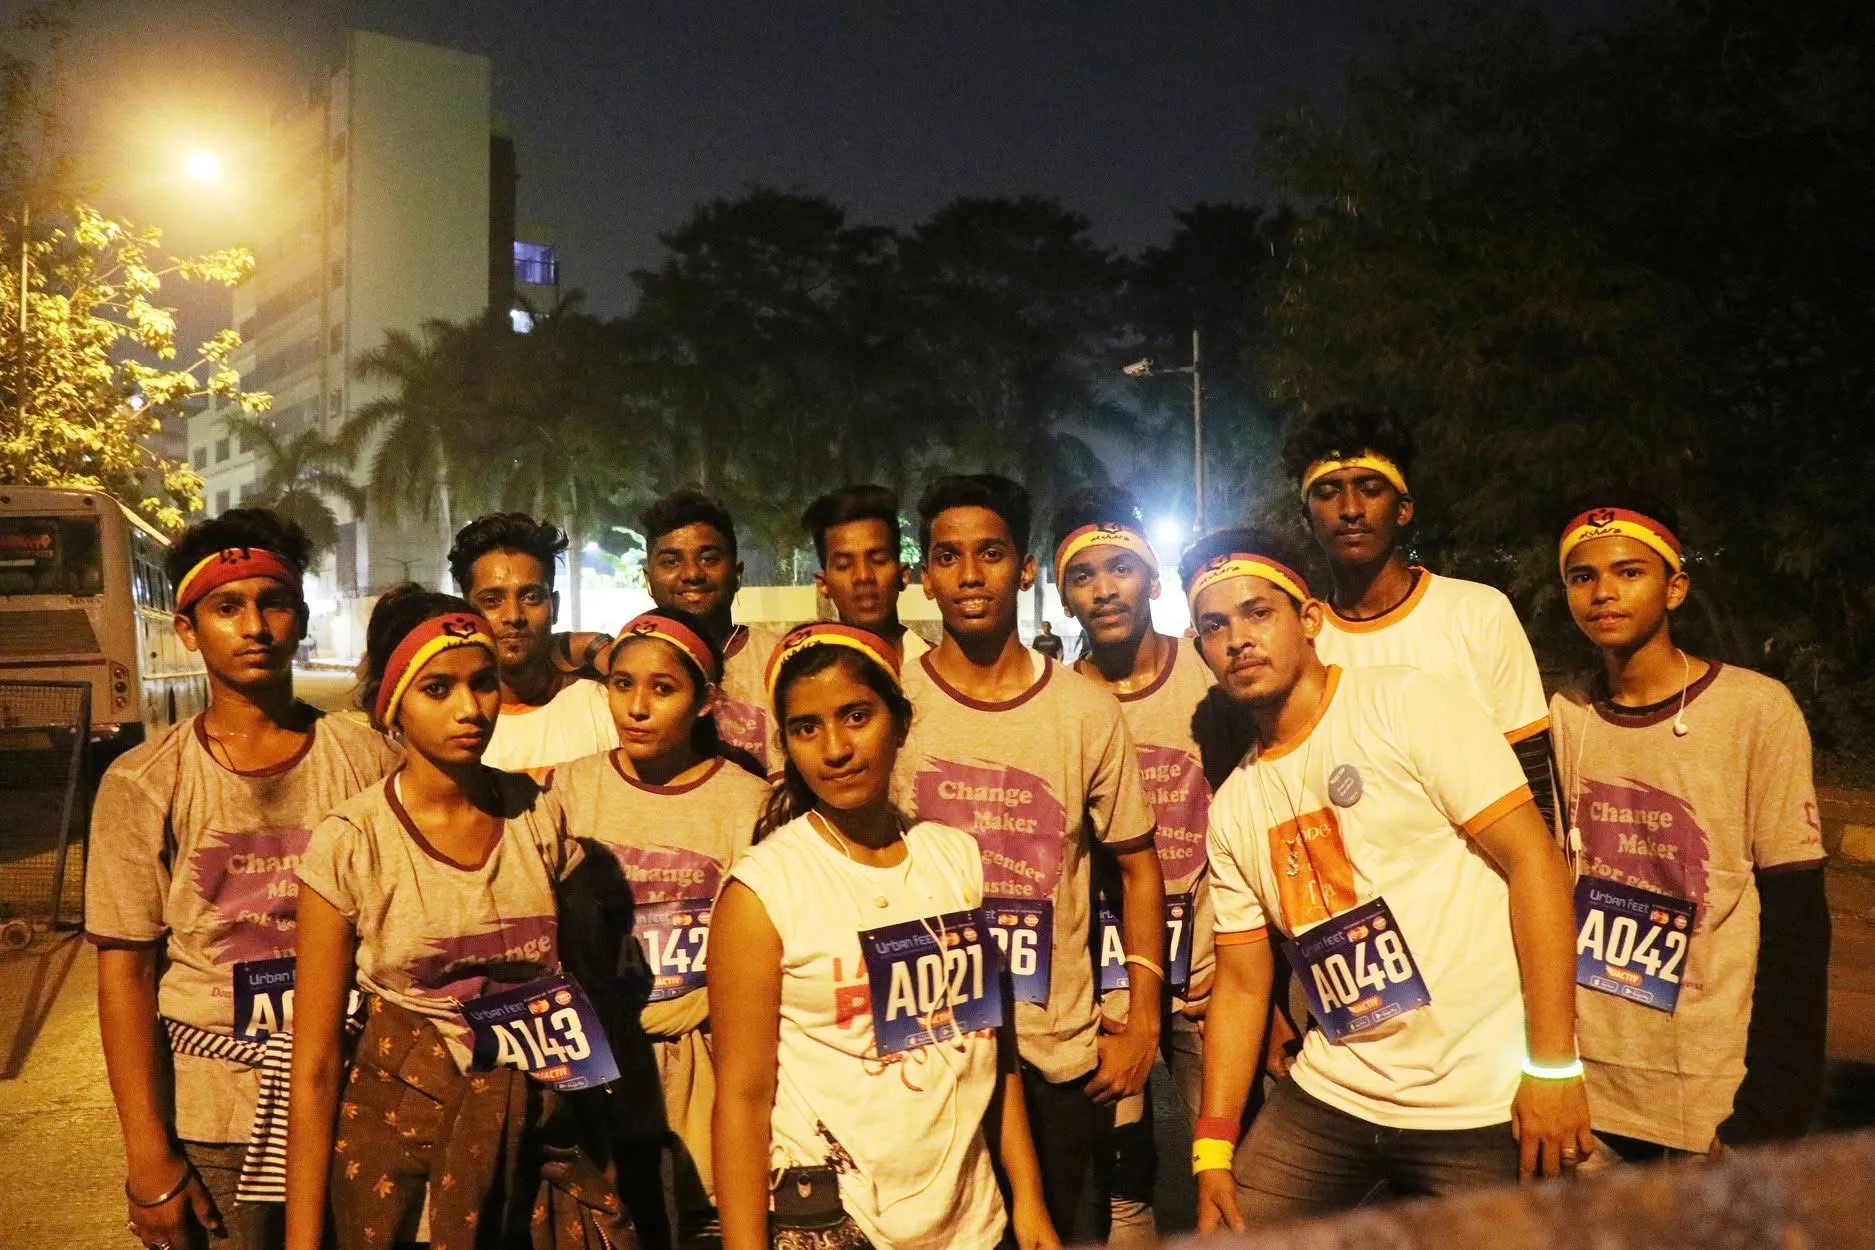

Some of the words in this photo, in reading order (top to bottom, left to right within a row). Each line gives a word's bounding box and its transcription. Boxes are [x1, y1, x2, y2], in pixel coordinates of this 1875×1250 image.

[938, 780, 1034, 808] Change
[973, 810, 1039, 834] Maker
[1590, 801, 1674, 832] Change
[1617, 833, 1680, 861] Maker
[227, 853, 300, 876] Chan
[981, 849, 1046, 883] gender
[983, 880, 1034, 897] ustice
[1576, 908, 1688, 984] A042
[885, 943, 984, 1022] A021
[1310, 929, 1414, 1014] A048
[490, 1007, 591, 1071] A143
